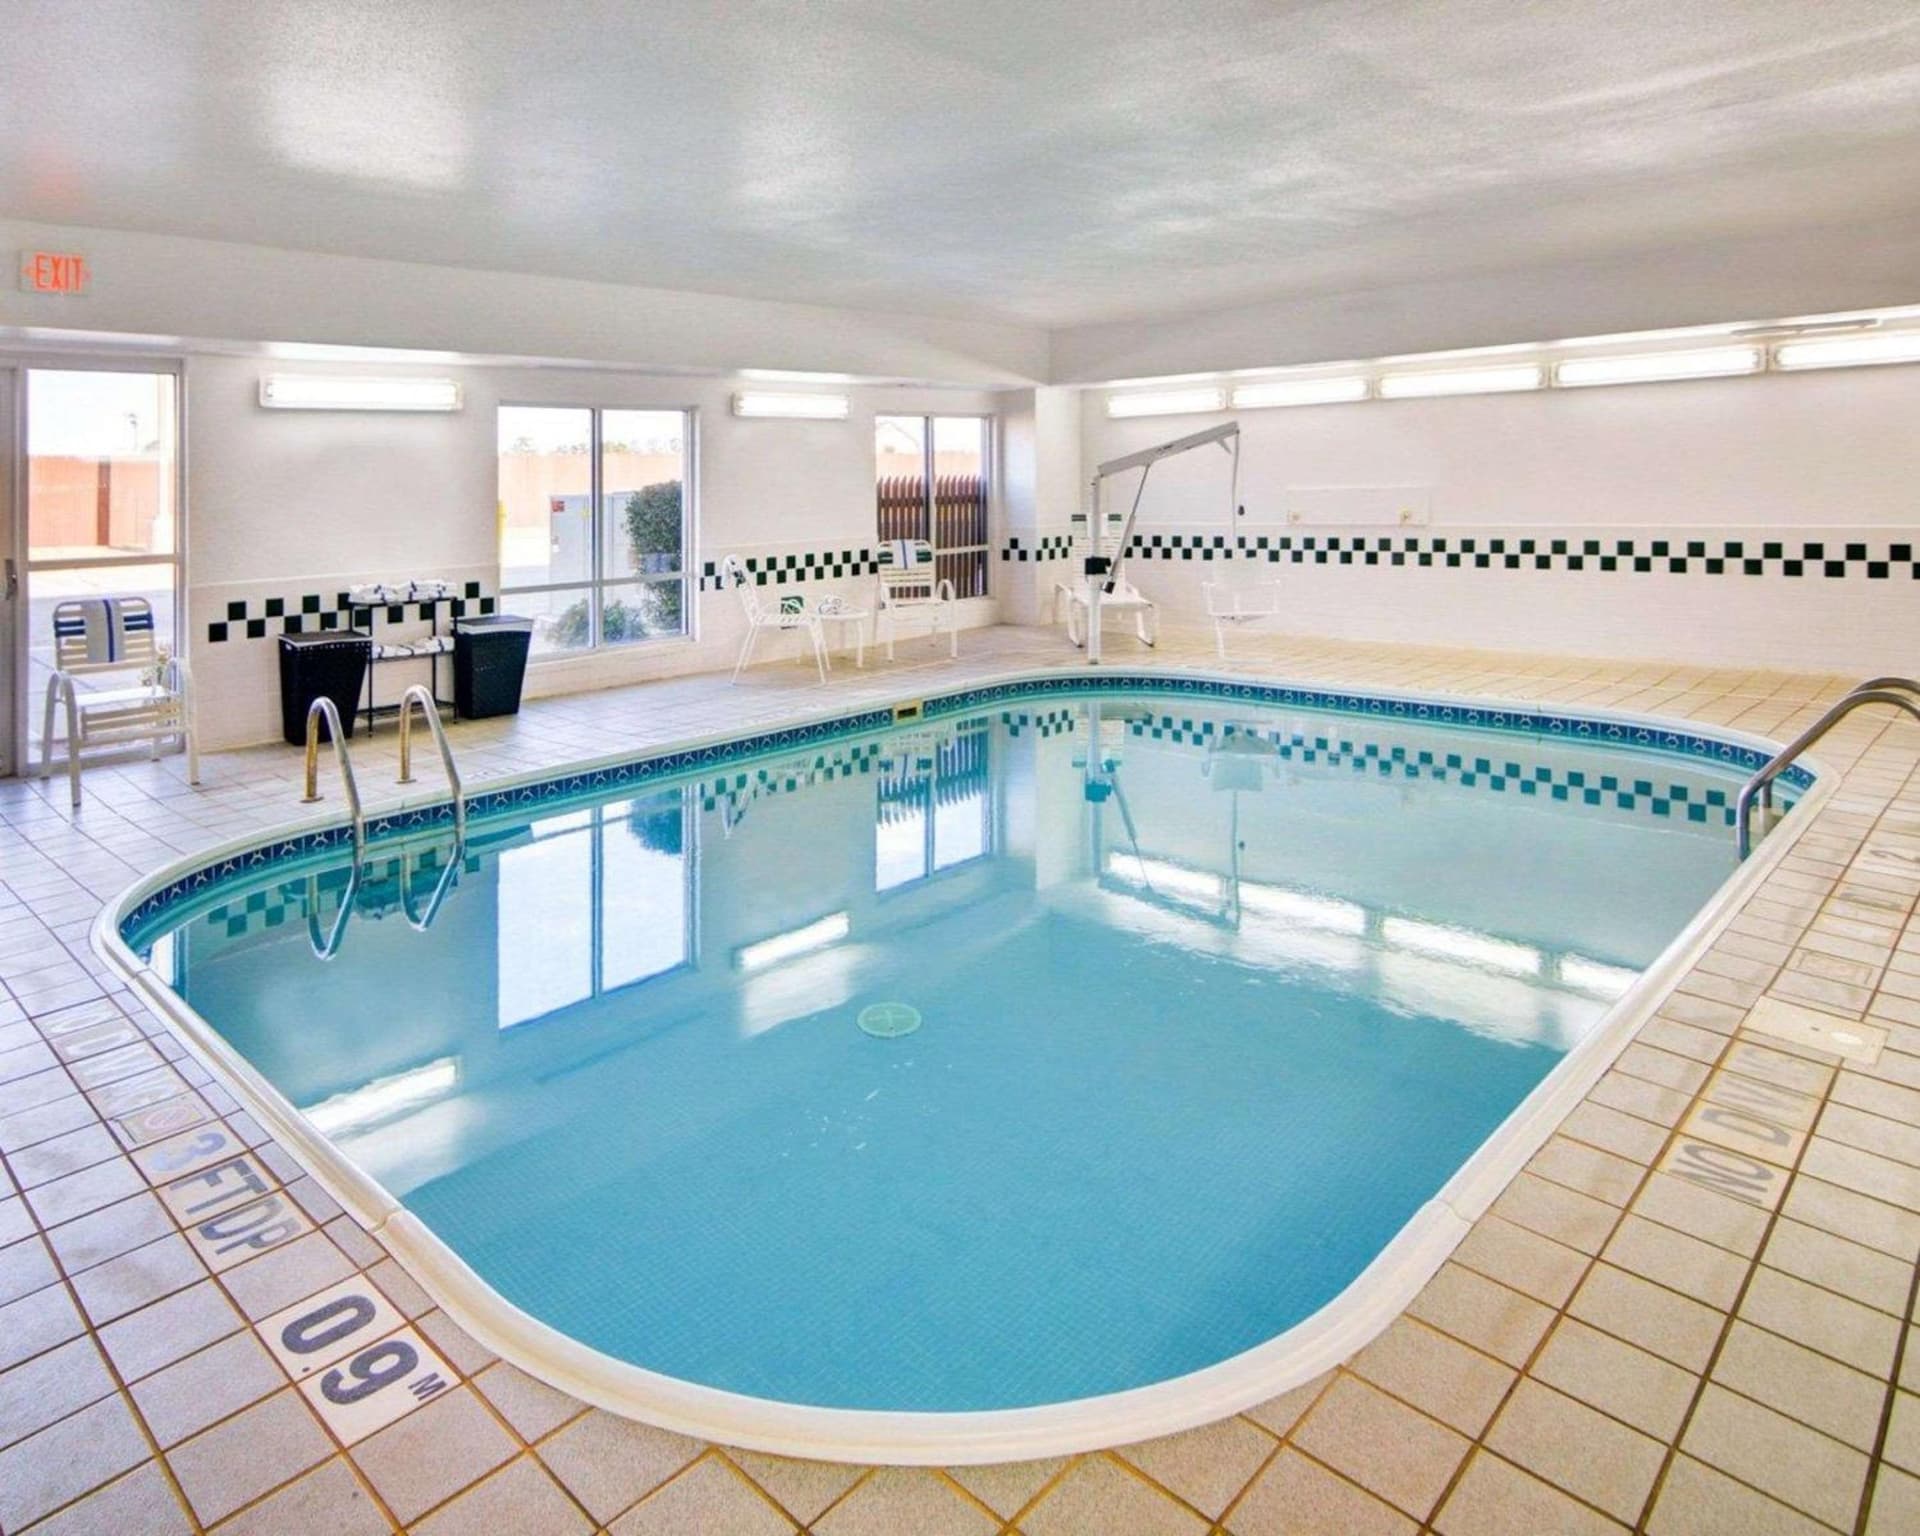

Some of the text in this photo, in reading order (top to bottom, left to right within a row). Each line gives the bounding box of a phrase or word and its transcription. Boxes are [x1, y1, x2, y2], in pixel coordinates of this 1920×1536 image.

[35, 252, 84, 292] EXIT
[150, 1132, 227, 1172] 3
[1668, 1144, 1774, 1204] NO
